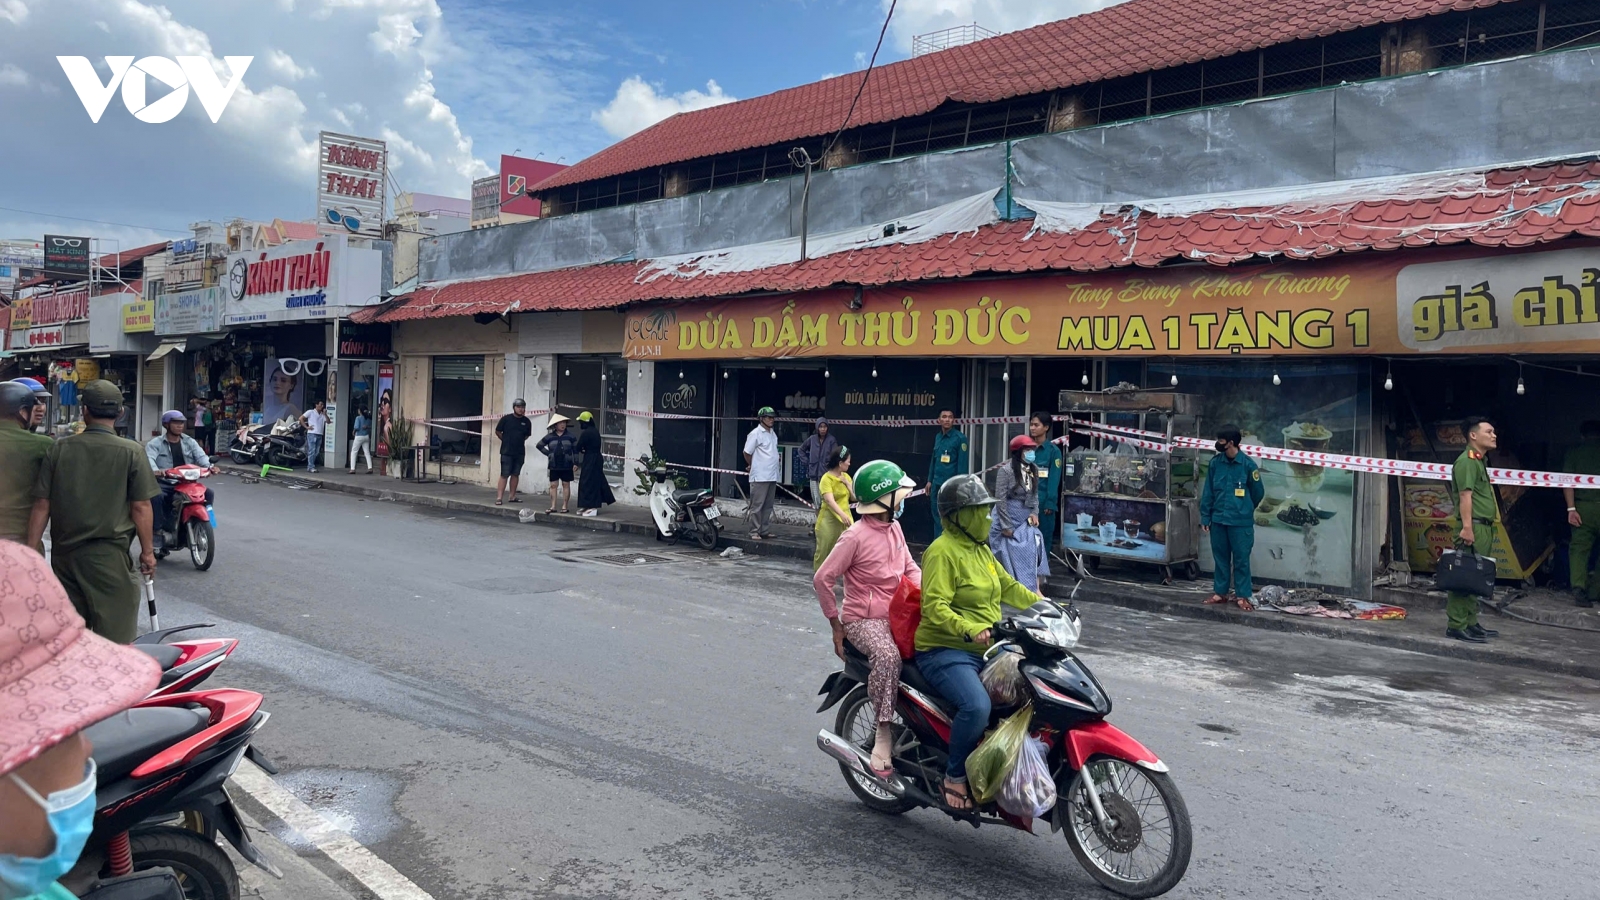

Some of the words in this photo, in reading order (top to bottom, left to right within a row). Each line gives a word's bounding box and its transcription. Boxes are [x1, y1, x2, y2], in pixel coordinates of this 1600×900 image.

[328, 142, 380, 171] KÍNH
[326, 173, 378, 198] THÁI
[246, 252, 287, 296] KÍNH
[287, 242, 331, 291] THÁI
[1189, 273, 1254, 300] Khai
[677, 311, 744, 351] DỪA
[750, 299, 830, 348] DẦM
[839, 296, 921, 347] THỦ
[931, 296, 1031, 346] ĐỨC
[1412, 280, 1499, 342] giá
[1056, 314, 1156, 352] MUA
[1161, 315, 1181, 350] 1
[1188, 307, 1335, 355] TẶNG
[1345, 308, 1370, 348] 1
[340, 337, 365, 355] KÍNH
[871, 478, 893, 492] Grab
